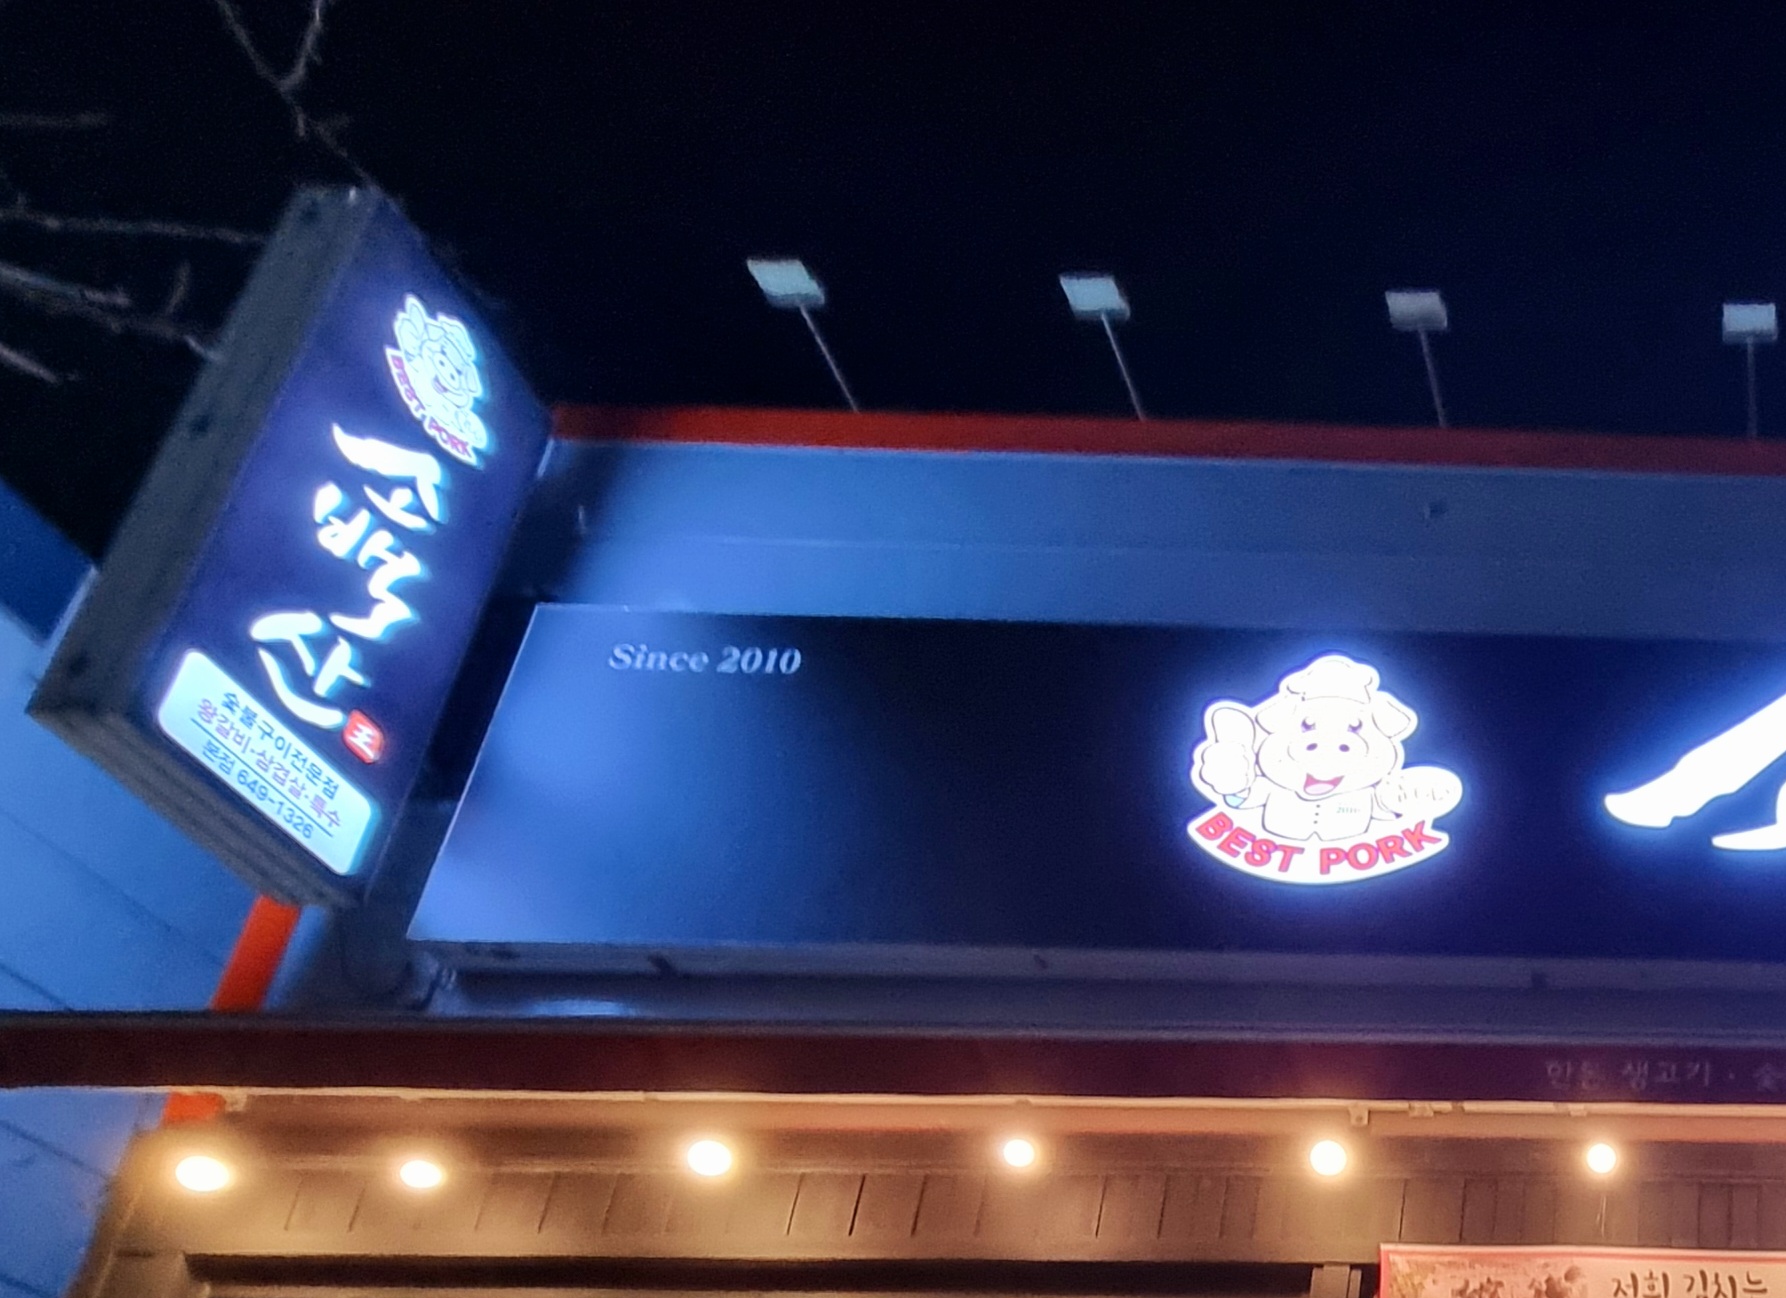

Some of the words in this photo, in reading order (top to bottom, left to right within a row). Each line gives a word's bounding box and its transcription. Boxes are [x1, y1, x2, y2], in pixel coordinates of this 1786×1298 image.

[609, 642, 709, 674] Since
[716, 645, 802, 677] 2010
[201, 738, 236, 777] 본점
[236, 766, 313, 841] 649-1326
[1195, 810, 1306, 872] BEST
[1318, 819, 1443, 875] PORK
